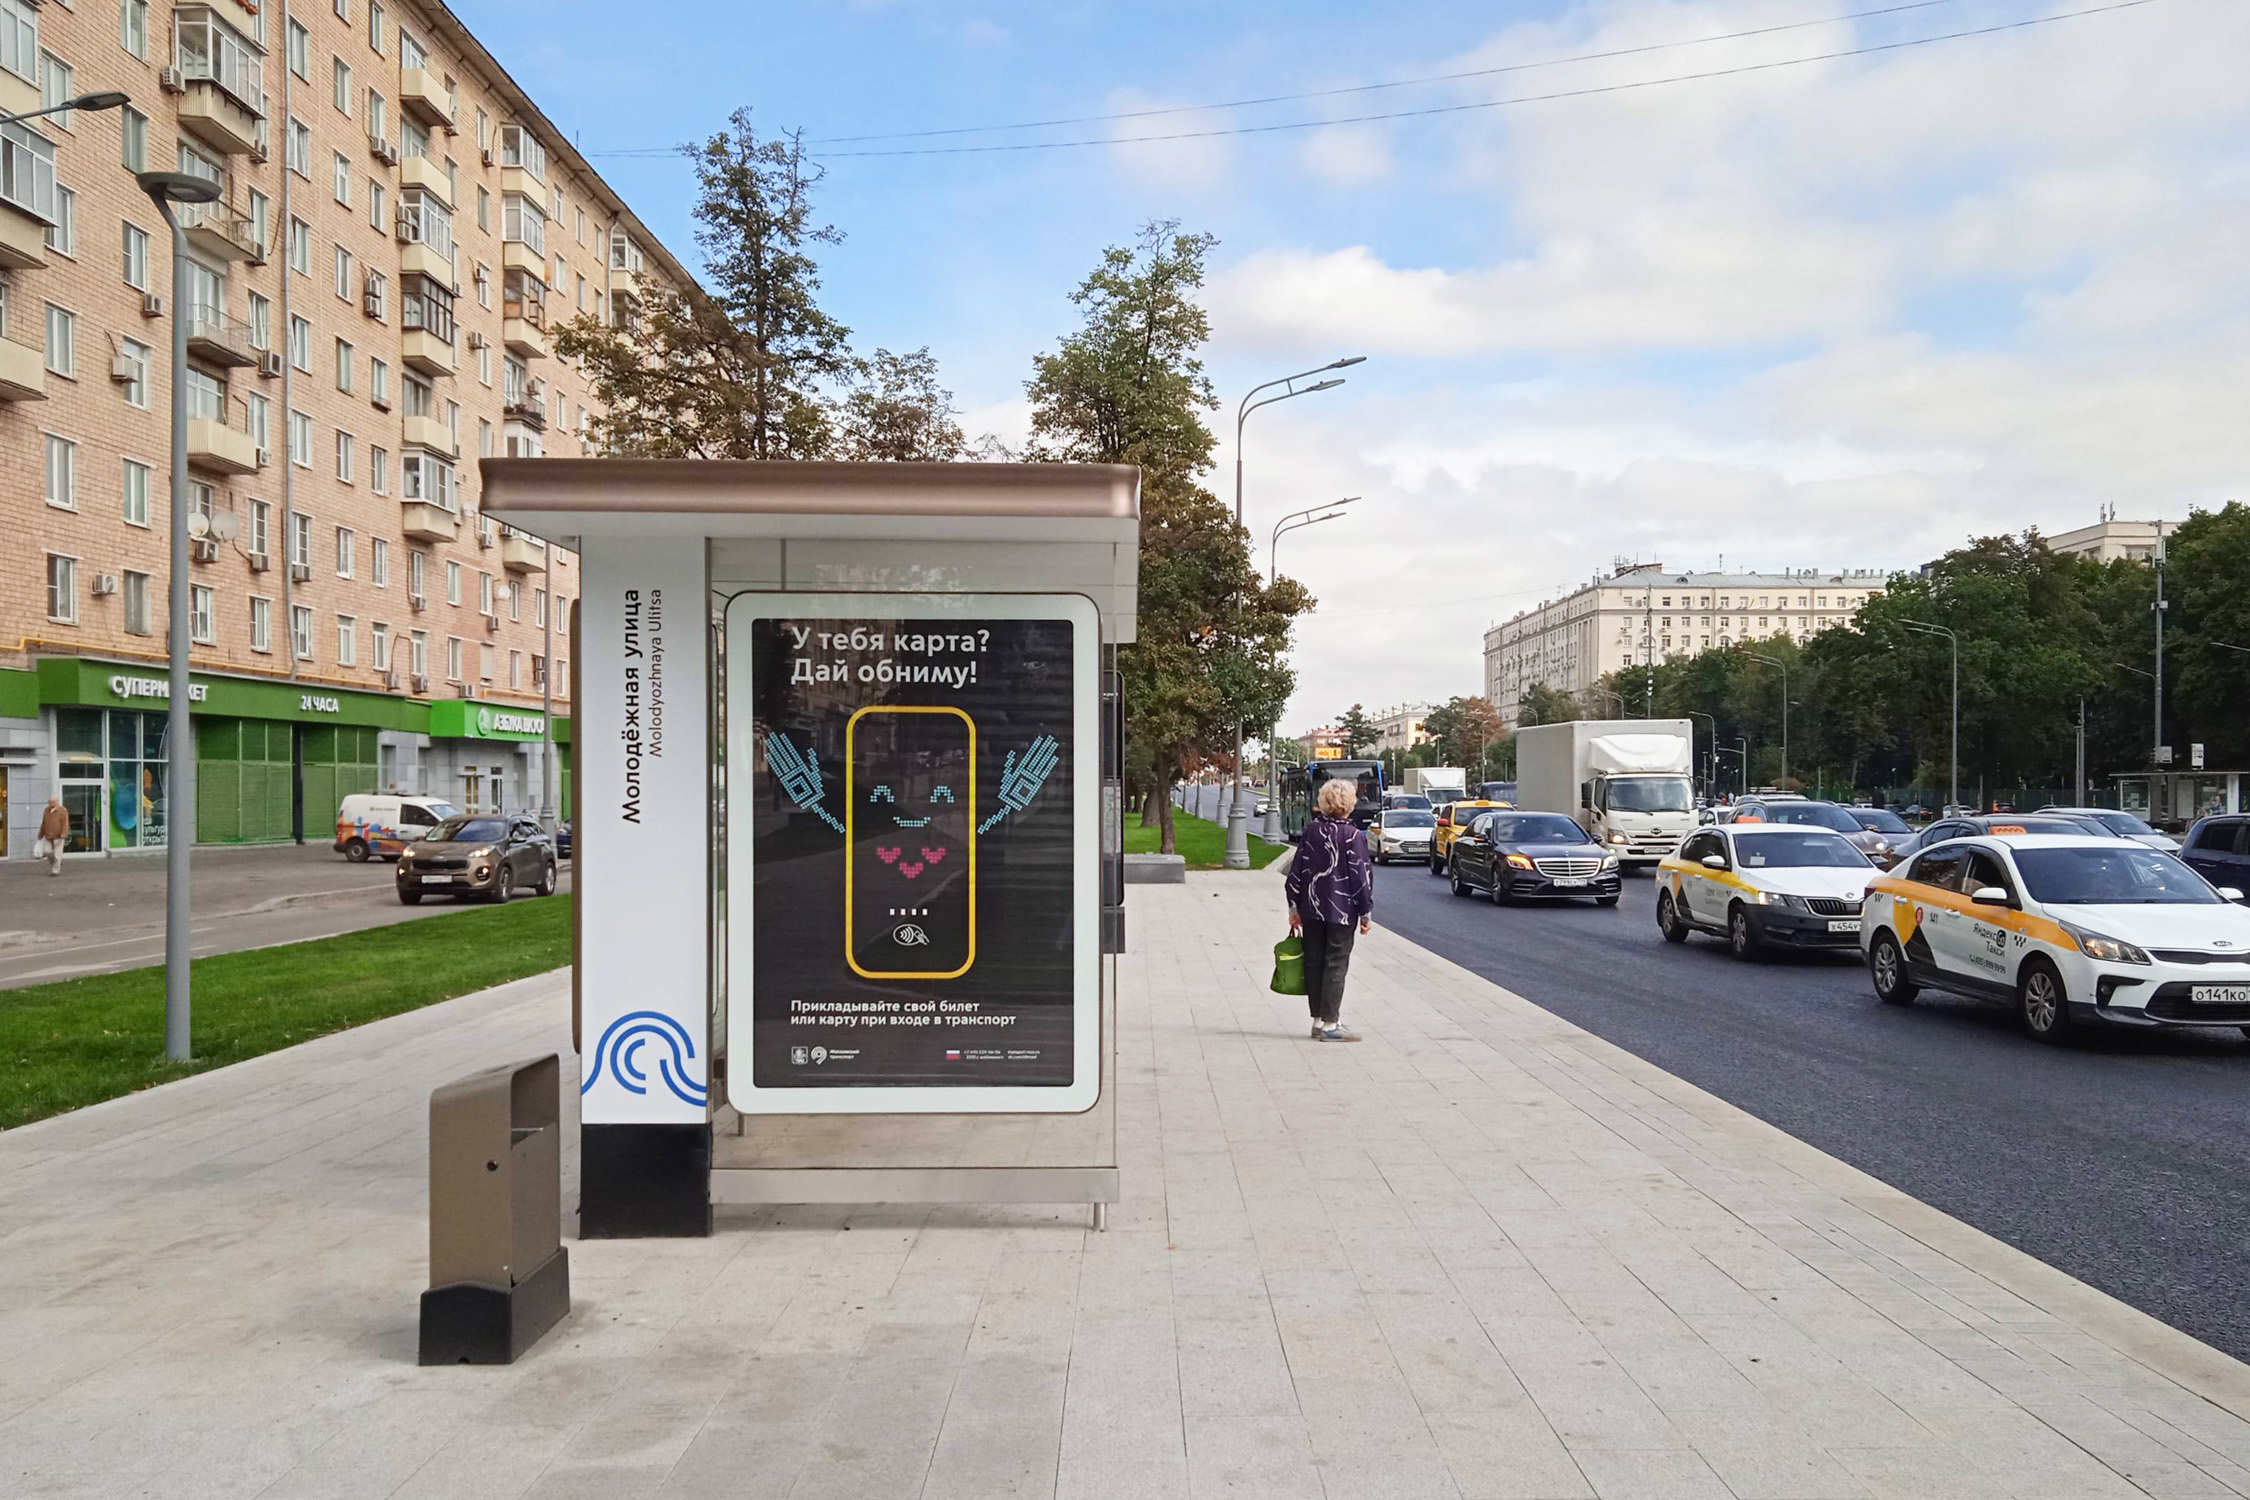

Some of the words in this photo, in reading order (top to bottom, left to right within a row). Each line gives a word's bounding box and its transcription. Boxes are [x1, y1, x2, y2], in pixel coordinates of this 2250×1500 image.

[624, 589, 643, 658] улица
[648, 589, 662, 632] Ulitsa
[792, 626, 811, 649] У
[818, 627, 884, 650] тебя
[894, 629, 990, 657] карта?
[791, 658, 848, 685] Дай
[858, 659, 977, 689] обниму!
[108, 675, 208, 701] СУПЕРМКЕТ
[648, 636, 664, 757] Molodyozhnaya
[301, 695, 312, 710] 24
[312, 696, 338, 712] ЧАСА
[621, 667, 643, 824] Молодёжная
[1973, 923, 1997, 941] Яндекс
[1985, 941, 2005, 957] Такси
[791, 1000, 900, 1013] Прикладывайте
[904, 1000, 936, 1012] свой
[939, 1000, 979, 1012] билет
[791, 1016, 815, 1025] или
[819, 1016, 858, 1027] карту
[861, 1016, 886, 1027] при
[890, 1016, 930, 1027] входе
[934, 1016, 941, 1025] в
[945, 1016, 1016, 1027] транспорт
